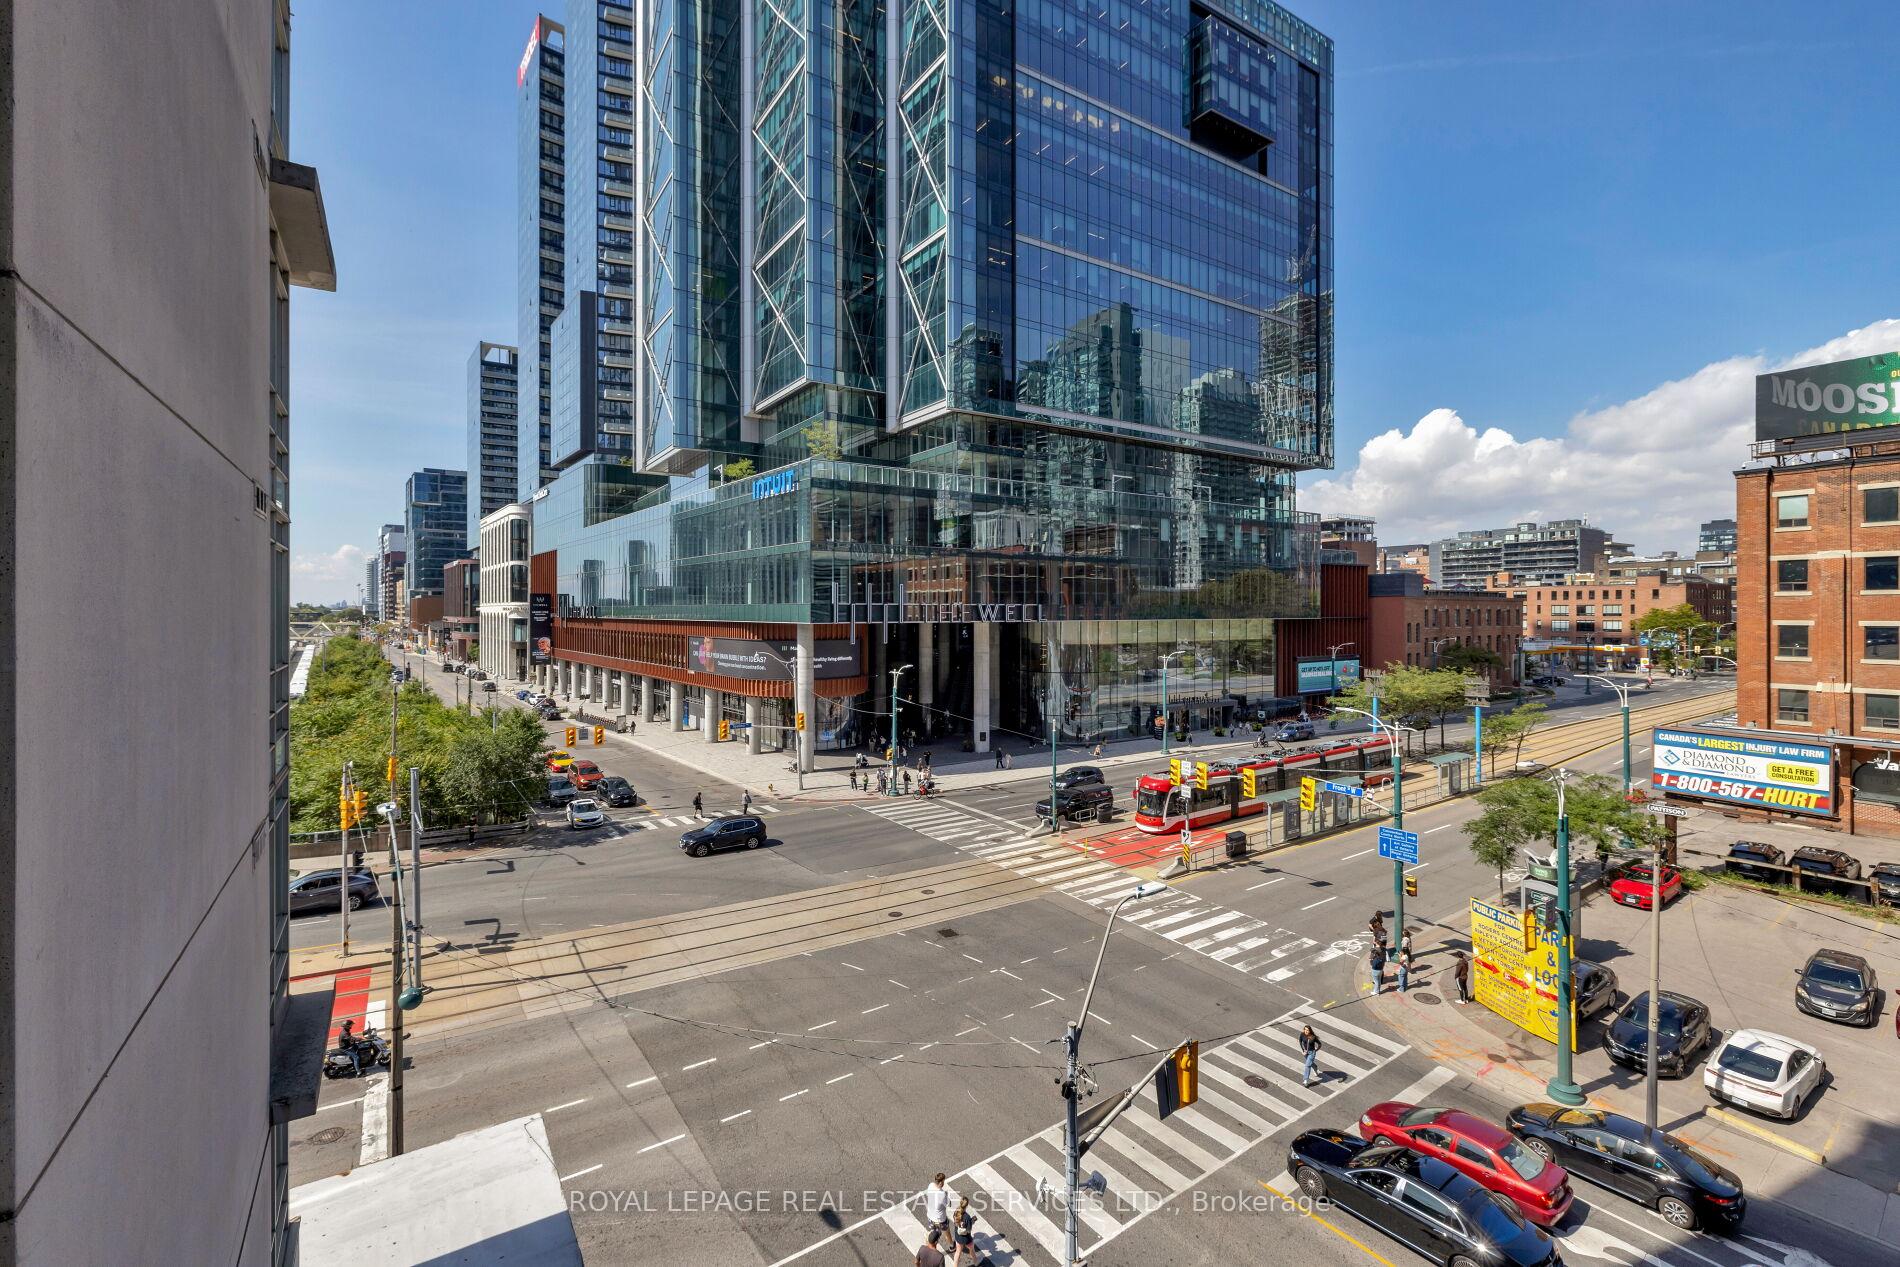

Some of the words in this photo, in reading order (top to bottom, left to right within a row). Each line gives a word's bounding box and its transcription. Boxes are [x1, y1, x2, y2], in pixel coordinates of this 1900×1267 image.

[1658, 733, 1698, 744] CANADA'S
[1698, 738, 1745, 752] LARGEST
[1746, 743, 1777, 754] INJURY
[1778, 746, 1800, 756] LAW
[1800, 748, 1824, 758] FIRM
[1682, 750, 1746, 765] DIAMOND
[1772, 766, 1786, 774] GET
[1772, 772, 1815, 783] CONSULTATION
[1333, 784, 1346, 792] Front
[1660, 774, 1825, 809] 1-800-567-HURT
[1650, 805, 1684, 816] PATTISON
[1473, 902, 1496, 919] PUBLIC
[1498, 912, 1524, 930] PARKIN
[1494, 923, 1506, 931] FOR
[1502, 932, 1522, 946] CENTRE
[1536, 926, 1559, 948] PAR
[1547, 951, 1556, 967] &
